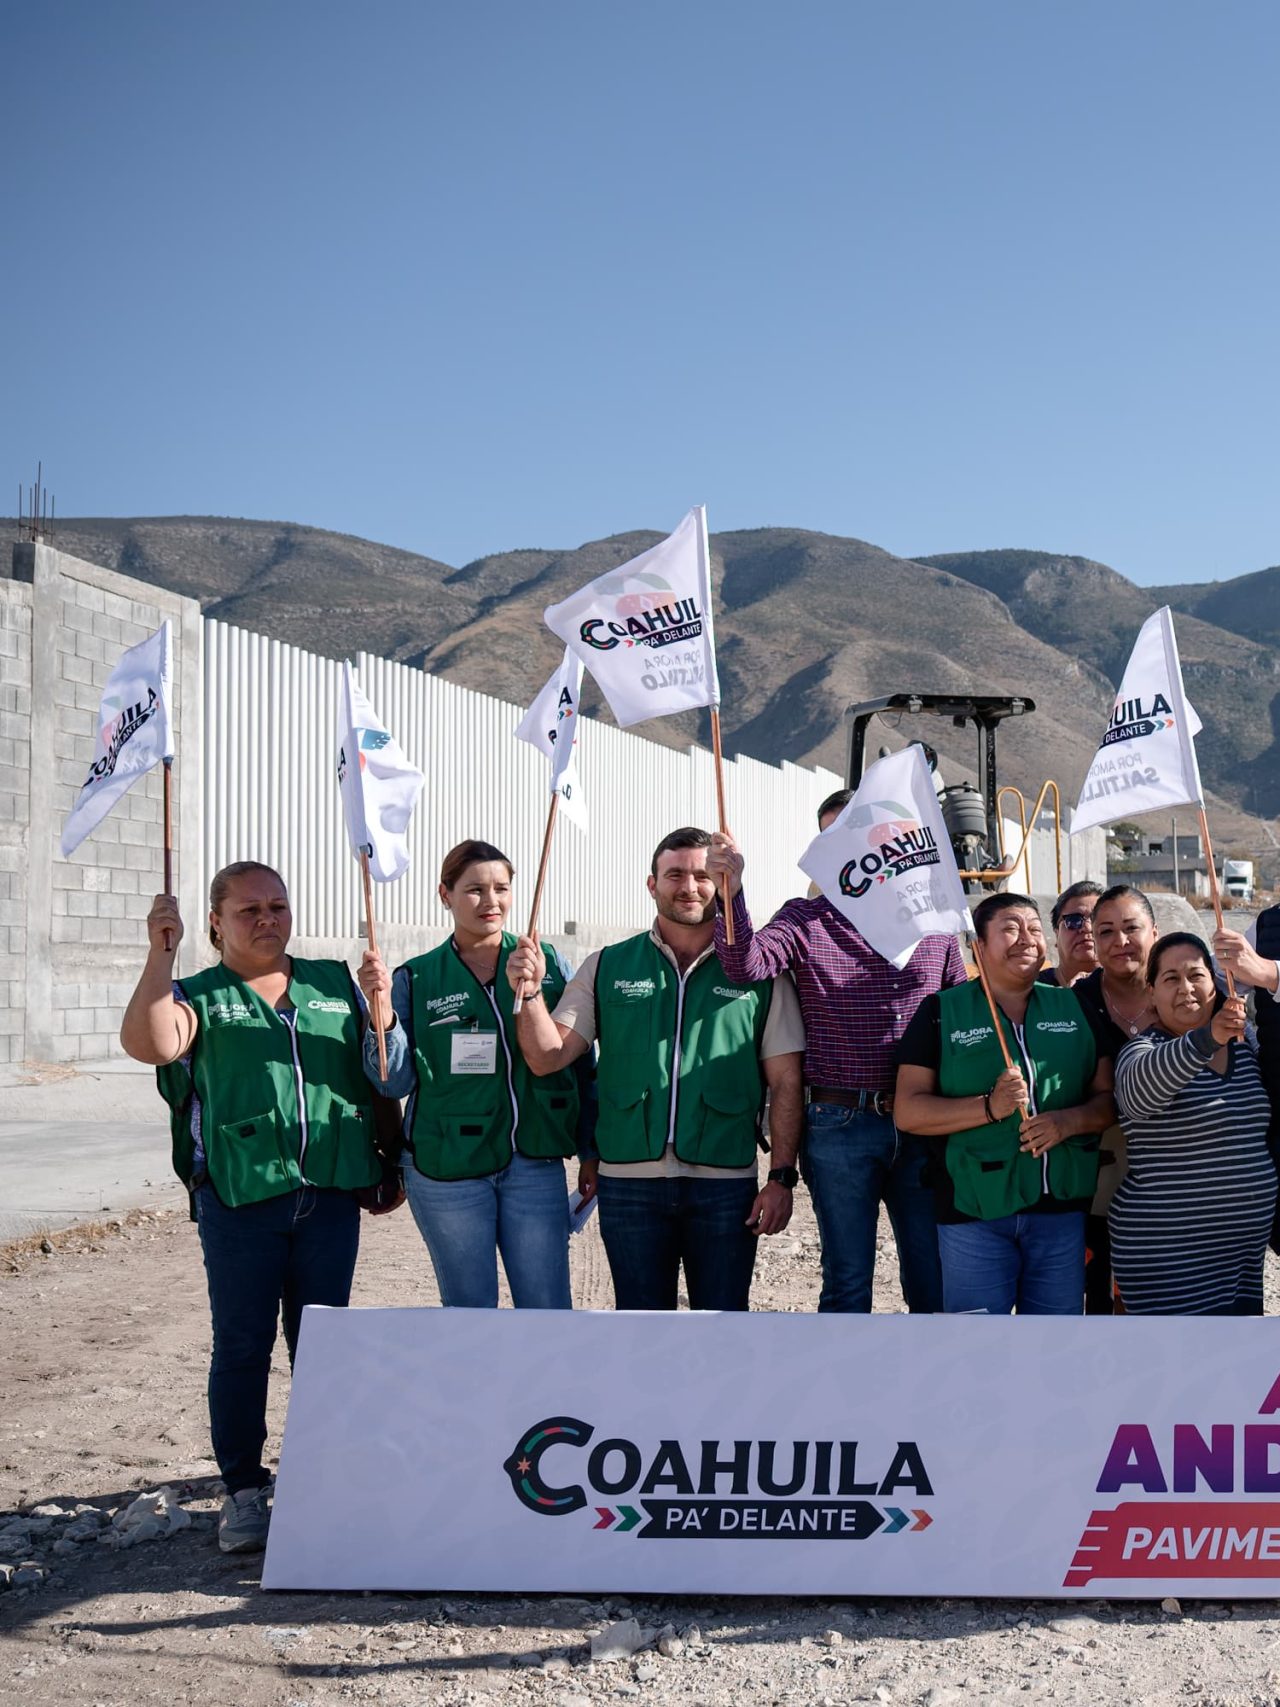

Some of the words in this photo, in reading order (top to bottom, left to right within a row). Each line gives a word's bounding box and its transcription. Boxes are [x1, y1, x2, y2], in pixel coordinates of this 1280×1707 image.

[580, 598, 701, 650] COAHUIL
[1109, 693, 1172, 728] UILA
[1105, 724, 1147, 743] DELANTE
[839, 826, 936, 898] COAHUIL
[427, 992, 470, 1010] MEJORA
[436, 1002, 464, 1014] COAHUILA
[951, 1026, 993, 1042] MEJORA
[503, 1416, 935, 1516] COAHUILA
[719, 1508, 857, 1531] DELANTE
